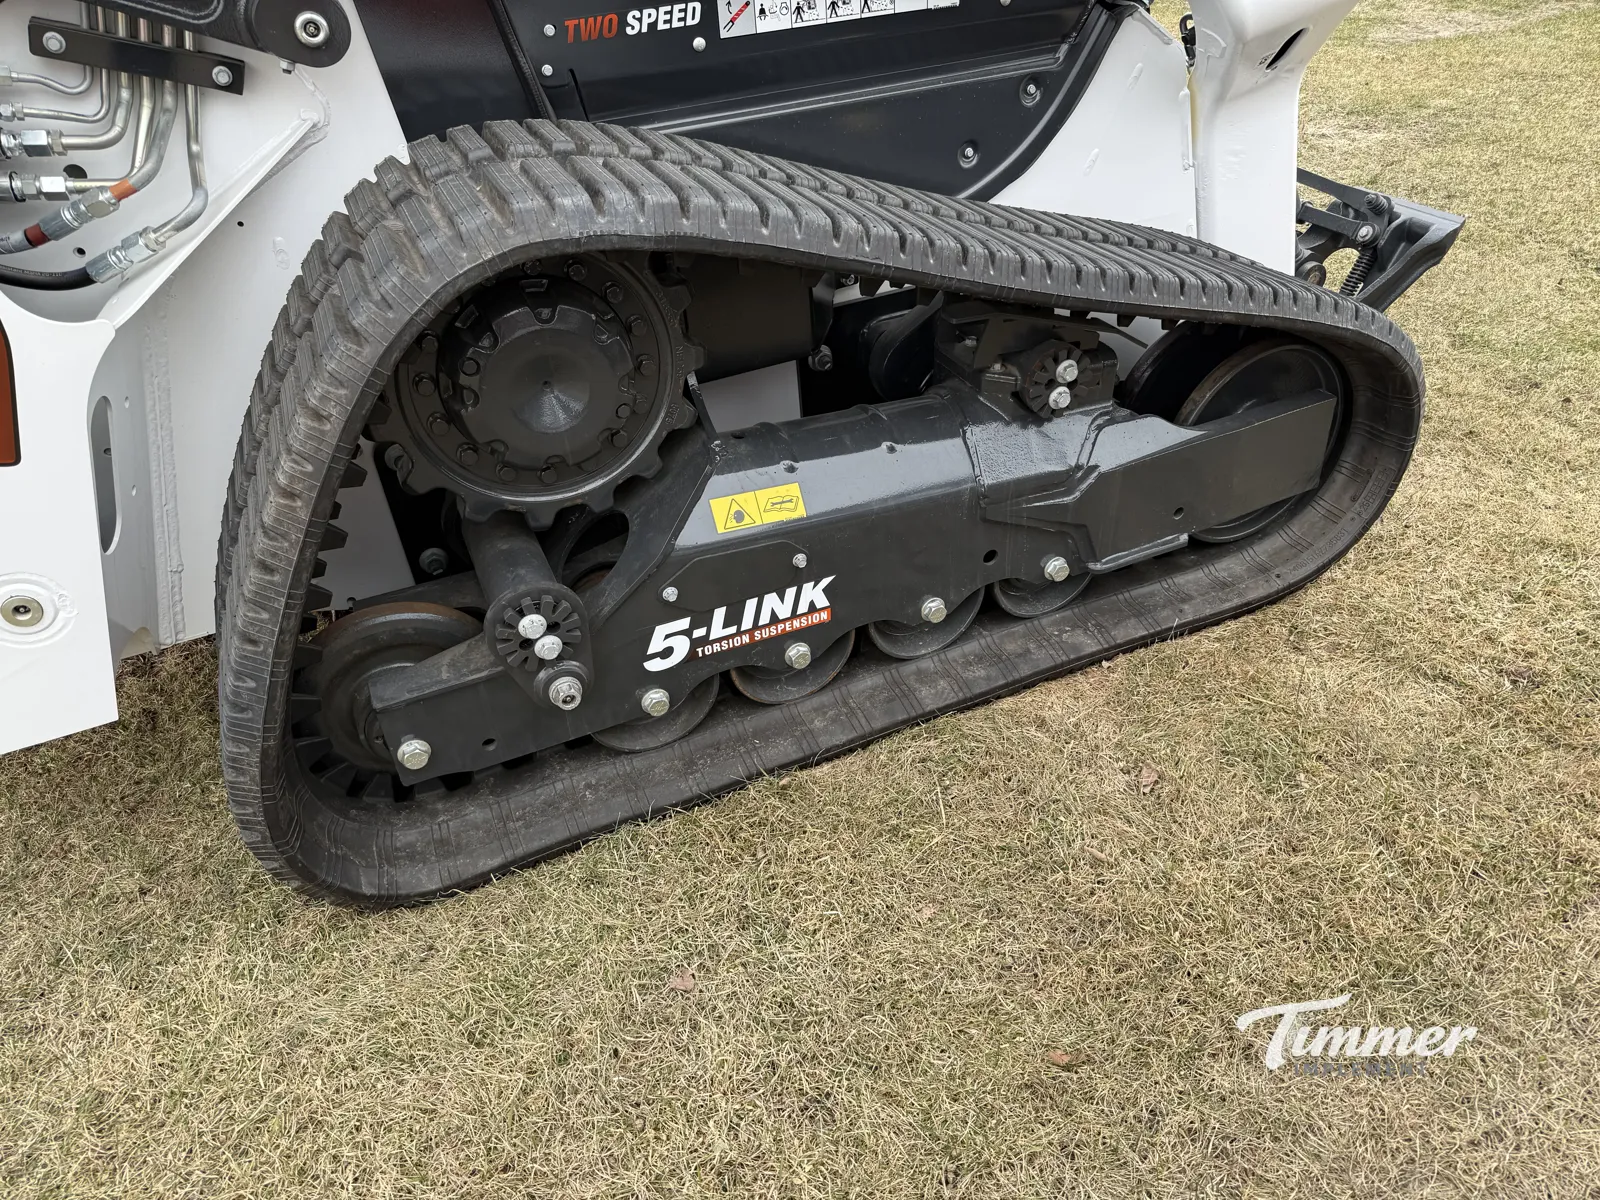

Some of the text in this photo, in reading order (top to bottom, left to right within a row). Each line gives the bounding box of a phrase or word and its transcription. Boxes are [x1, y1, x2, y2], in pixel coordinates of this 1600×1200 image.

[564, 1, 702, 44] TWO SPEED
[643, 575, 836, 672] 5-LINK
[696, 610, 828, 657] TORSION SUSPENSION
